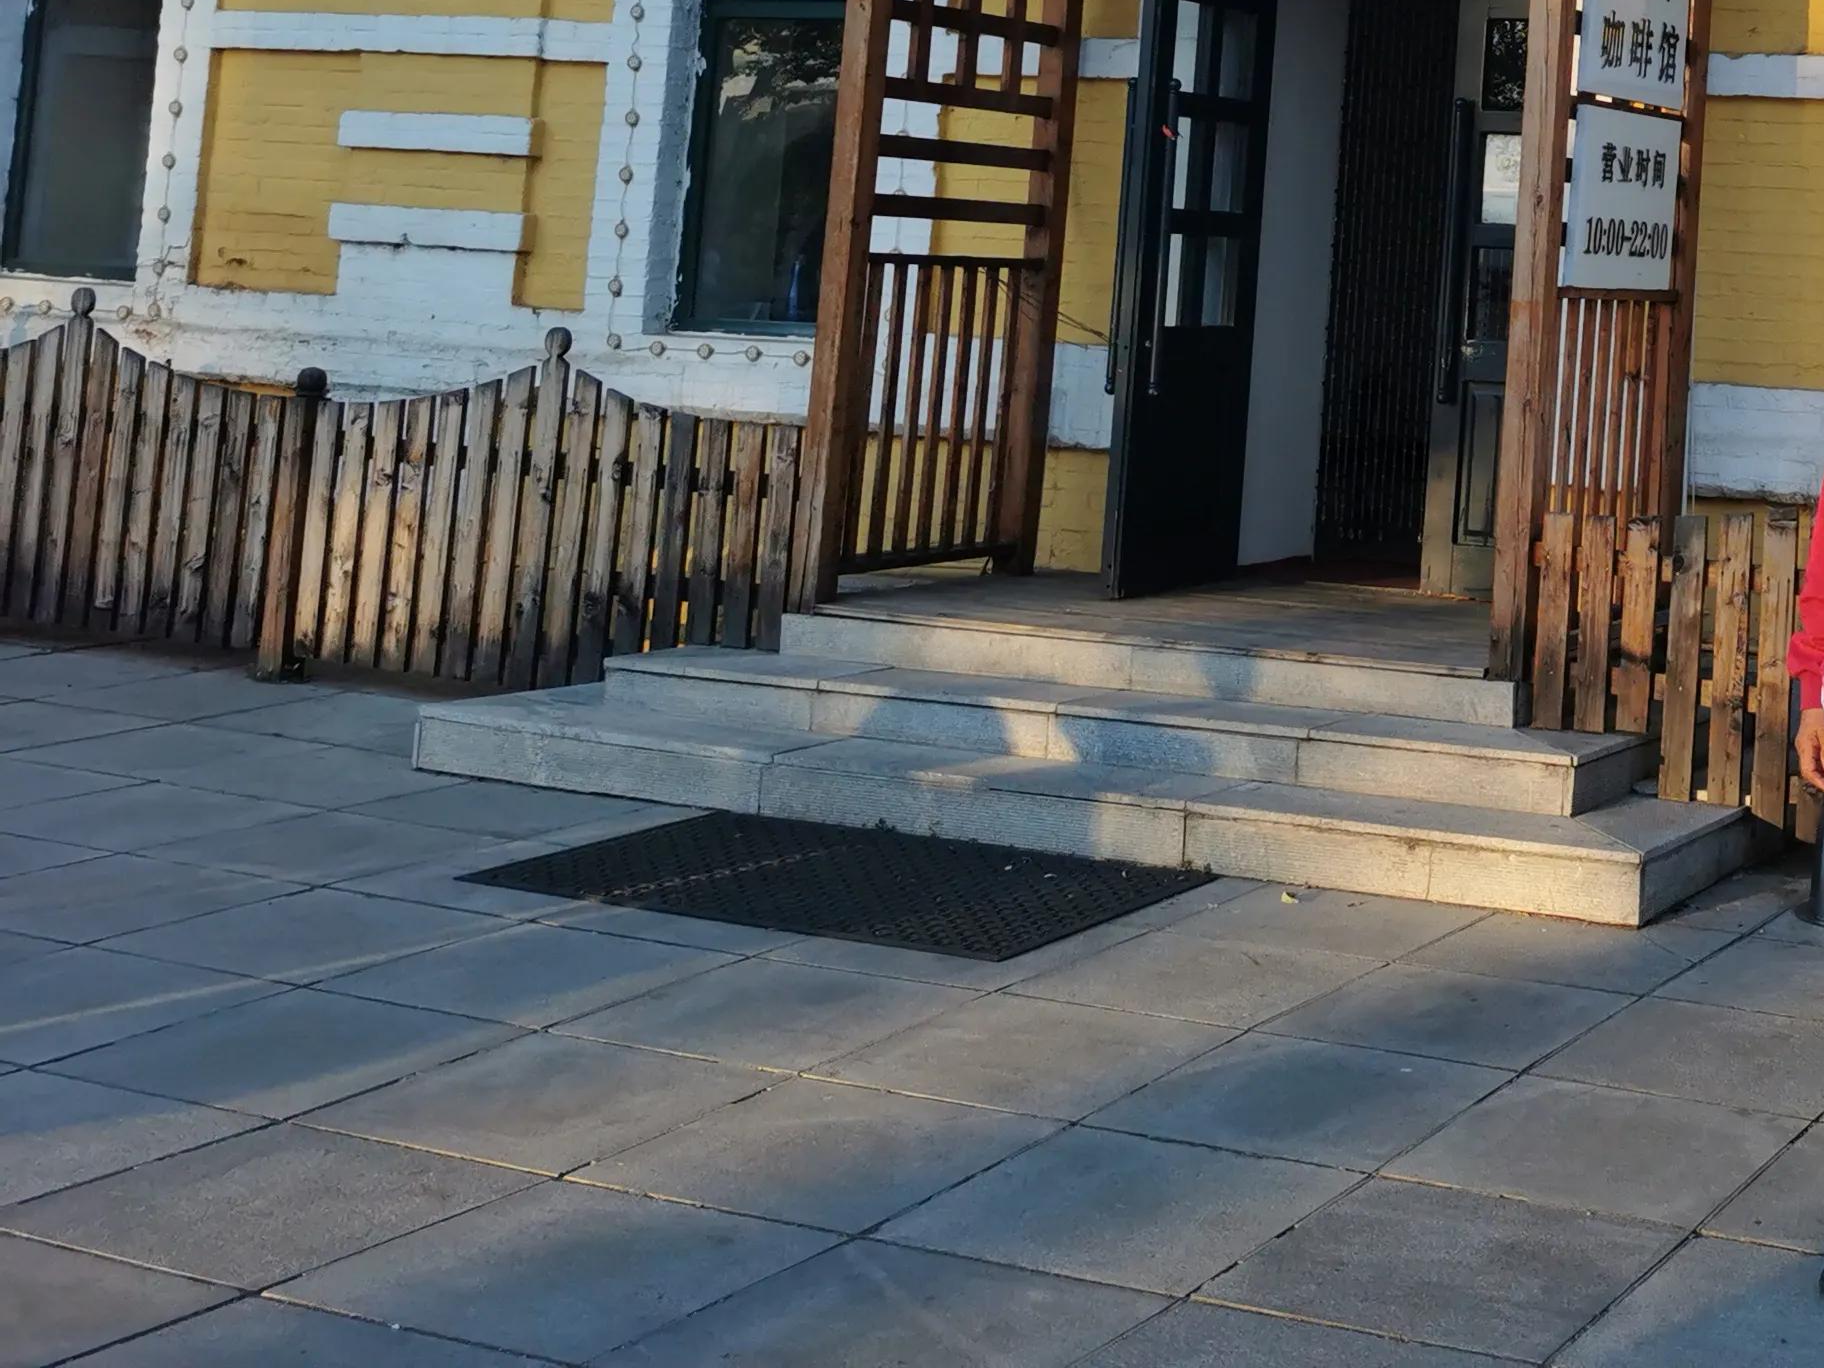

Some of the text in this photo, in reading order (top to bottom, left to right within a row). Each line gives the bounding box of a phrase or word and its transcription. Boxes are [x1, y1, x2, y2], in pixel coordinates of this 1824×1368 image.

[1600, 9, 1680, 84] 咖啡馆
[1601, 142, 1666, 189] 营业时间
[1584, 217, 1668, 259] 10:00-22:00
